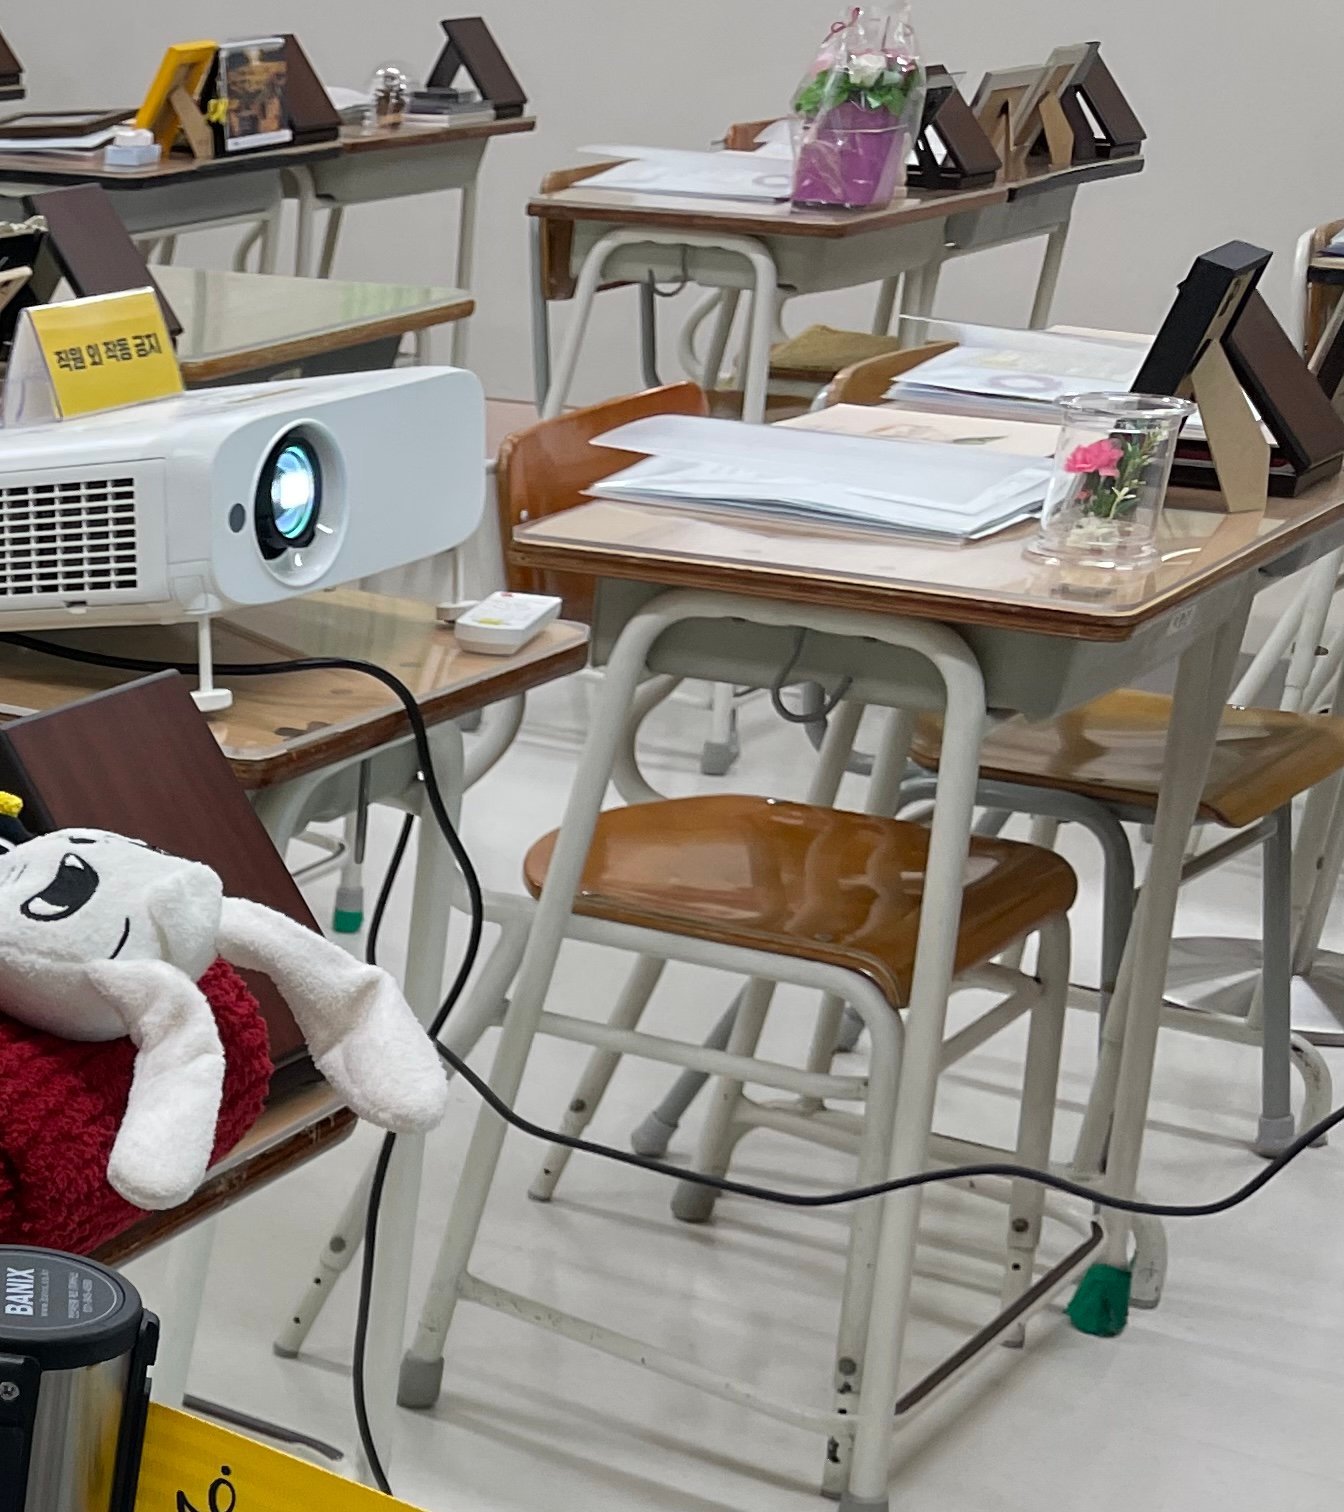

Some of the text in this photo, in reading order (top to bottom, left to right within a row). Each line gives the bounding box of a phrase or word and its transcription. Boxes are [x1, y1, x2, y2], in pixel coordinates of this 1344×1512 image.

[53, 345, 87, 372] 직원
[85, 343, 104, 366] 외
[102, 337, 133, 362] 작동
[5, 1267, 35, 1316] BANIX
